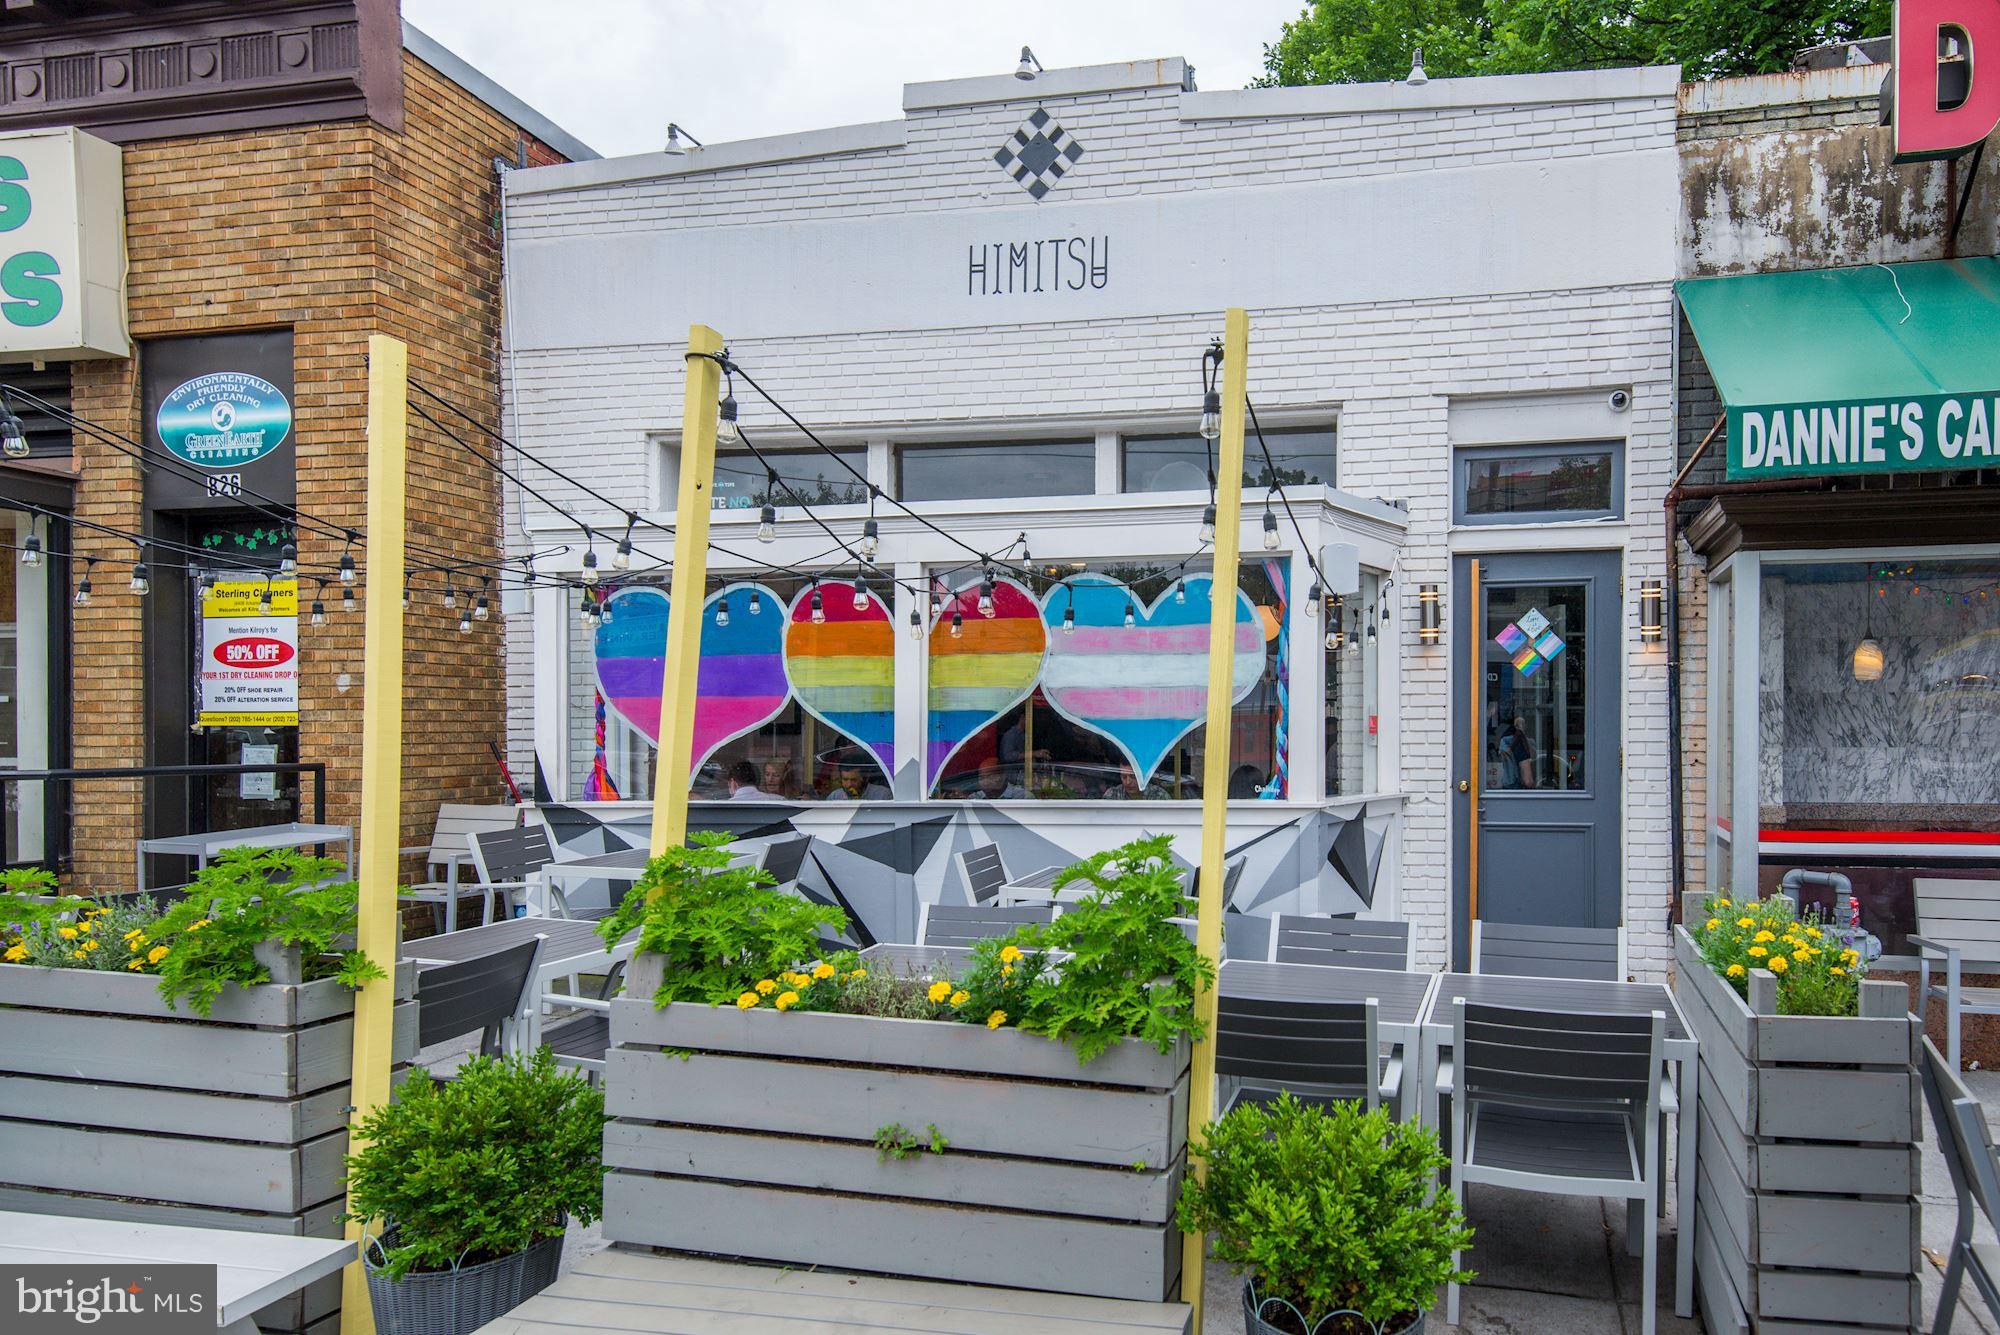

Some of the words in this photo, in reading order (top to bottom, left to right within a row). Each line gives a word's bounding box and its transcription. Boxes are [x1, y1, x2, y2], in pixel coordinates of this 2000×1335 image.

[969, 235, 1109, 296] HIMITSU
[171, 374, 275, 402] ENVIRONMENTALLY
[197, 383, 247, 397] FRIENDLY
[186, 397, 207, 412] DRY
[209, 392, 261, 409] CLEANING
[1741, 401, 1924, 469] DANNIE'S
[1936, 397, 2000, 459] CA
[189, 448, 259, 460] CLEANING
[208, 475, 240, 497] 826
[215, 589, 250, 599] Sterling
[253, 588, 294, 598] Clners
[226, 645, 253, 660] 50%
[256, 645, 279, 660] OFF
[274, 671, 291, 679] DROP
